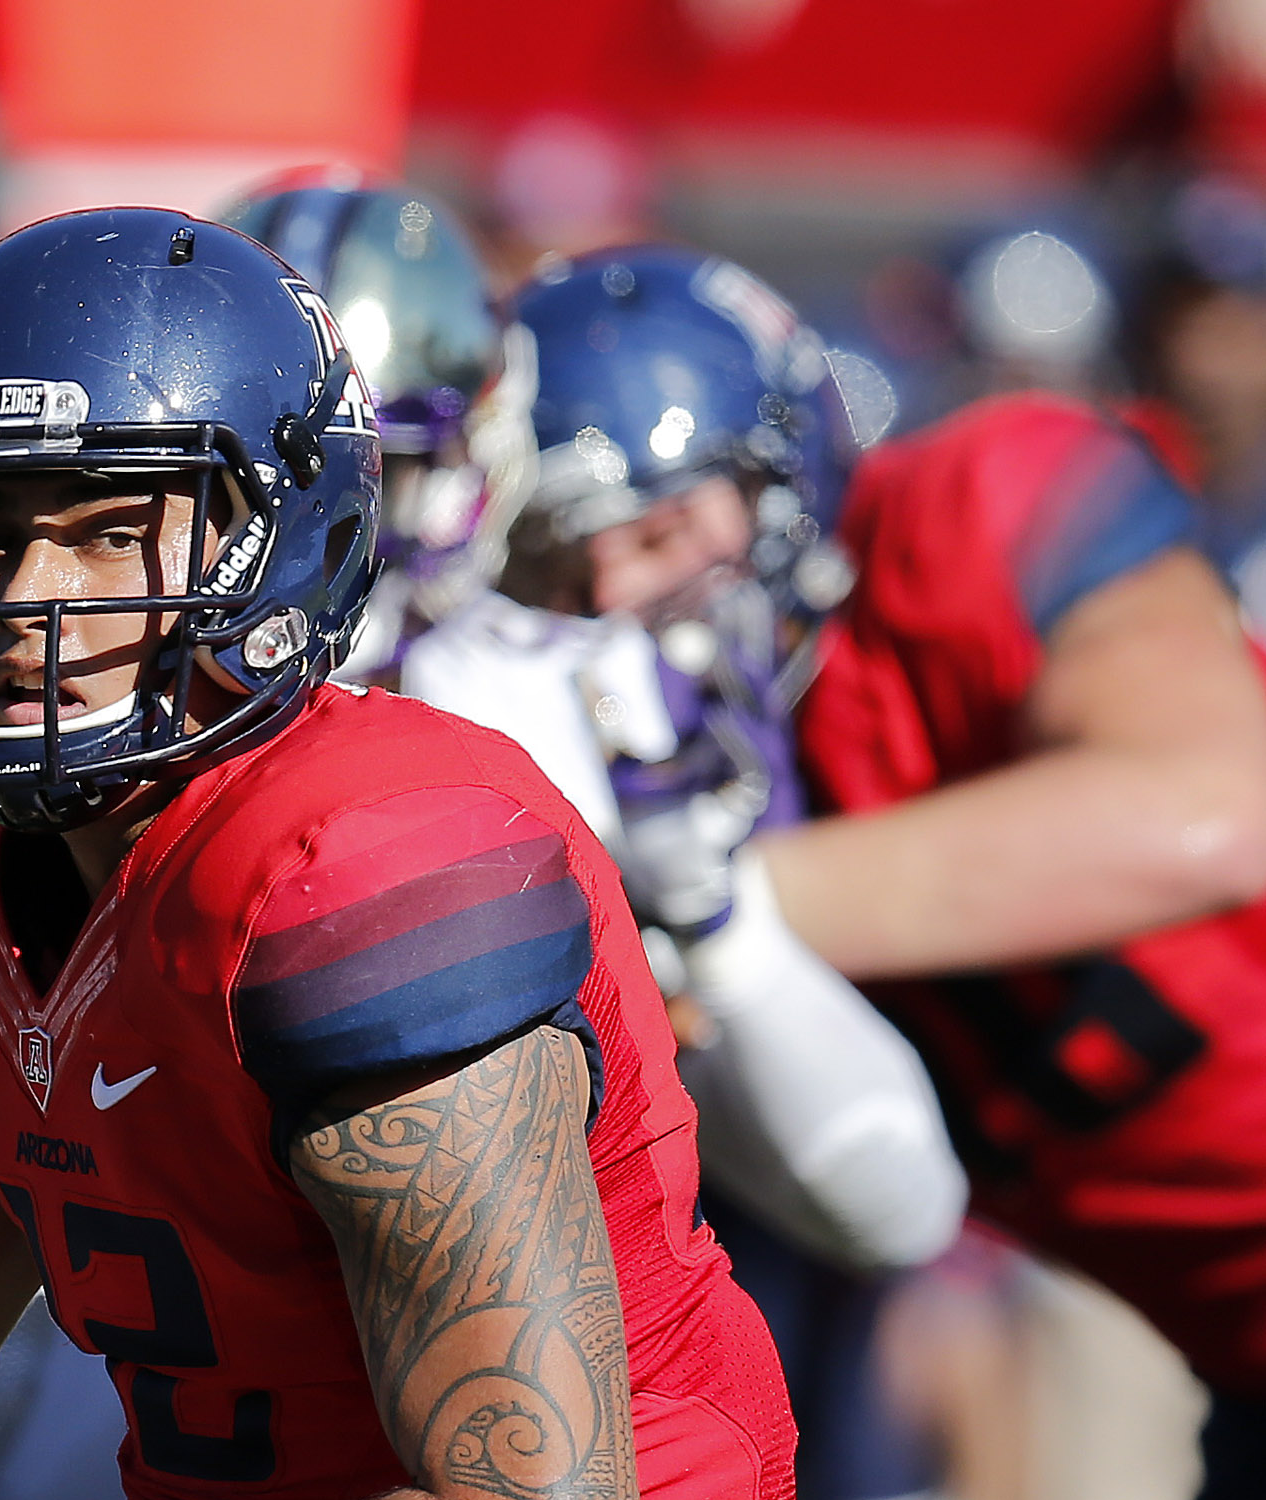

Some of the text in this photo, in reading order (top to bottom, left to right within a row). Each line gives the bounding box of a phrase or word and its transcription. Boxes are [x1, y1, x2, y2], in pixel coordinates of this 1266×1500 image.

[0, 385, 43, 415] EDGE
[200, 514, 267, 614] iddell
[15, 1130, 100, 1177] ARIZONA
